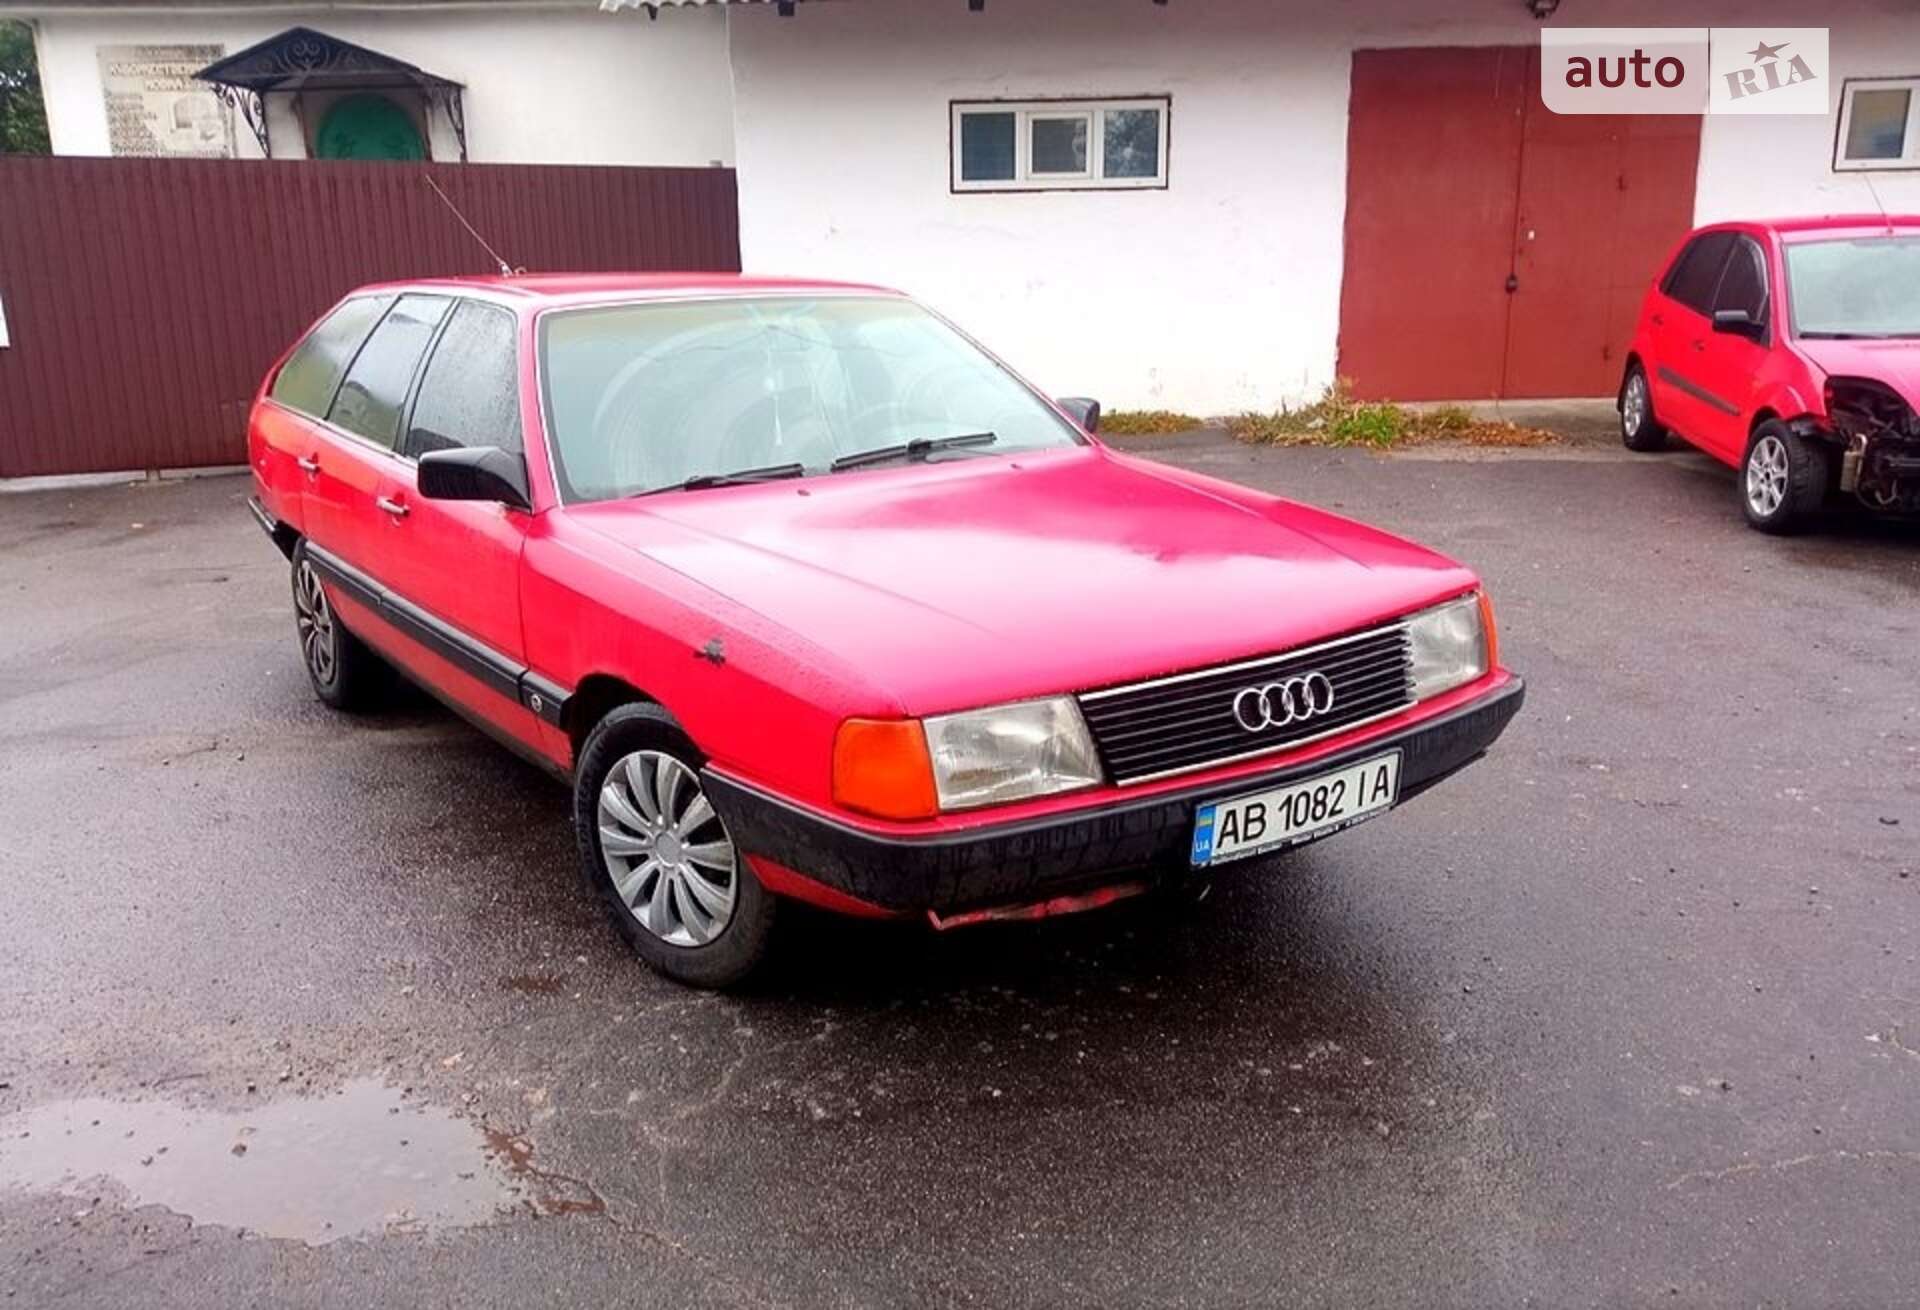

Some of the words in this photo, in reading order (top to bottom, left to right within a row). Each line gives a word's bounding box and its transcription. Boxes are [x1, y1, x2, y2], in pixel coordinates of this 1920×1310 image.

[1217, 803, 1266, 849] AB
[1278, 780, 1346, 831] 1082
[1358, 765, 1389, 807] IA
[1195, 839, 1210, 853] UA
